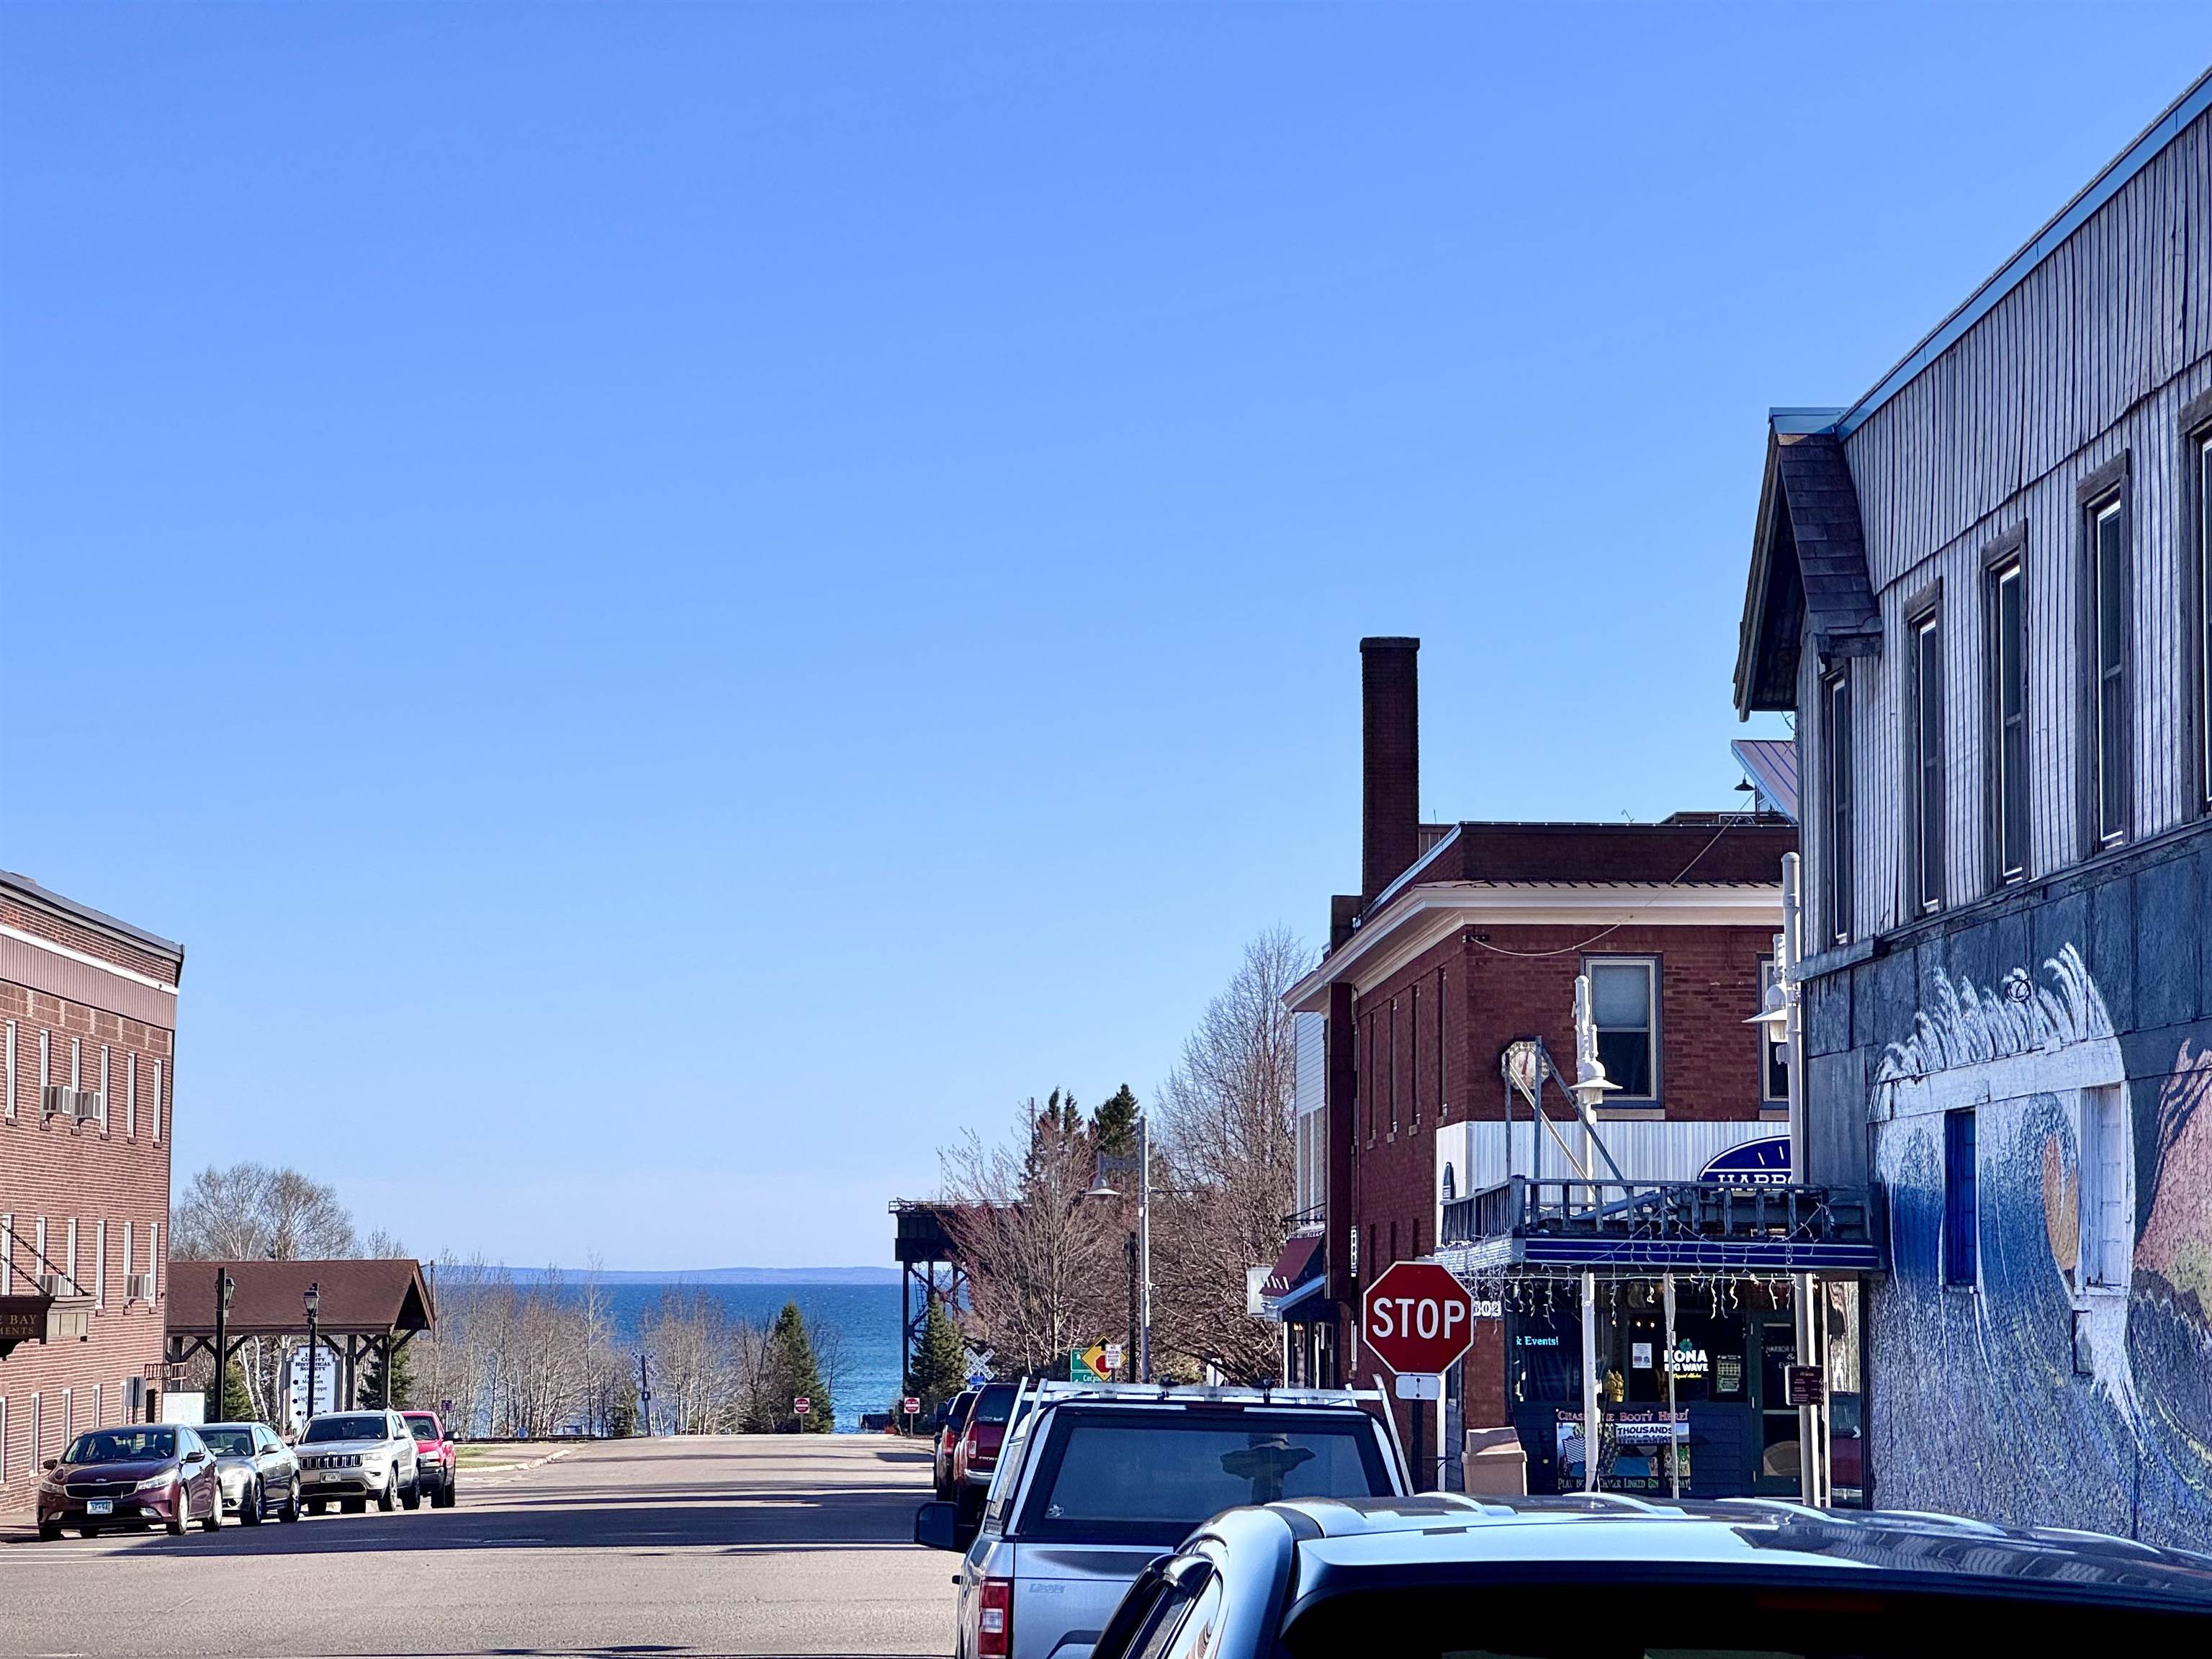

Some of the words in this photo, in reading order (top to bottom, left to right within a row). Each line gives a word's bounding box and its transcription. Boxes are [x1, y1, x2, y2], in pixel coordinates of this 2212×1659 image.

[1718, 1174, 1792, 1192] HARB
[1473, 1302, 1499, 1314] 602
[10, 1314, 37, 1325] BAY
[1372, 1297, 1465, 1339] STOP
[1524, 1336, 1559, 1346] Events!
[1663, 1349, 1708, 1363] KONA
[1664, 1363, 1681, 1372] BG
[1682, 1362, 1709, 1372] WAVE
[1557, 1411, 1585, 1421] CHAS
[1619, 1412, 1654, 1422] BOOTY
[1617, 1426, 1673, 1435] THOUSANDS
[1624, 1478, 1646, 1488] LINKED
[1668, 1478, 1691, 1489] TDAY!
